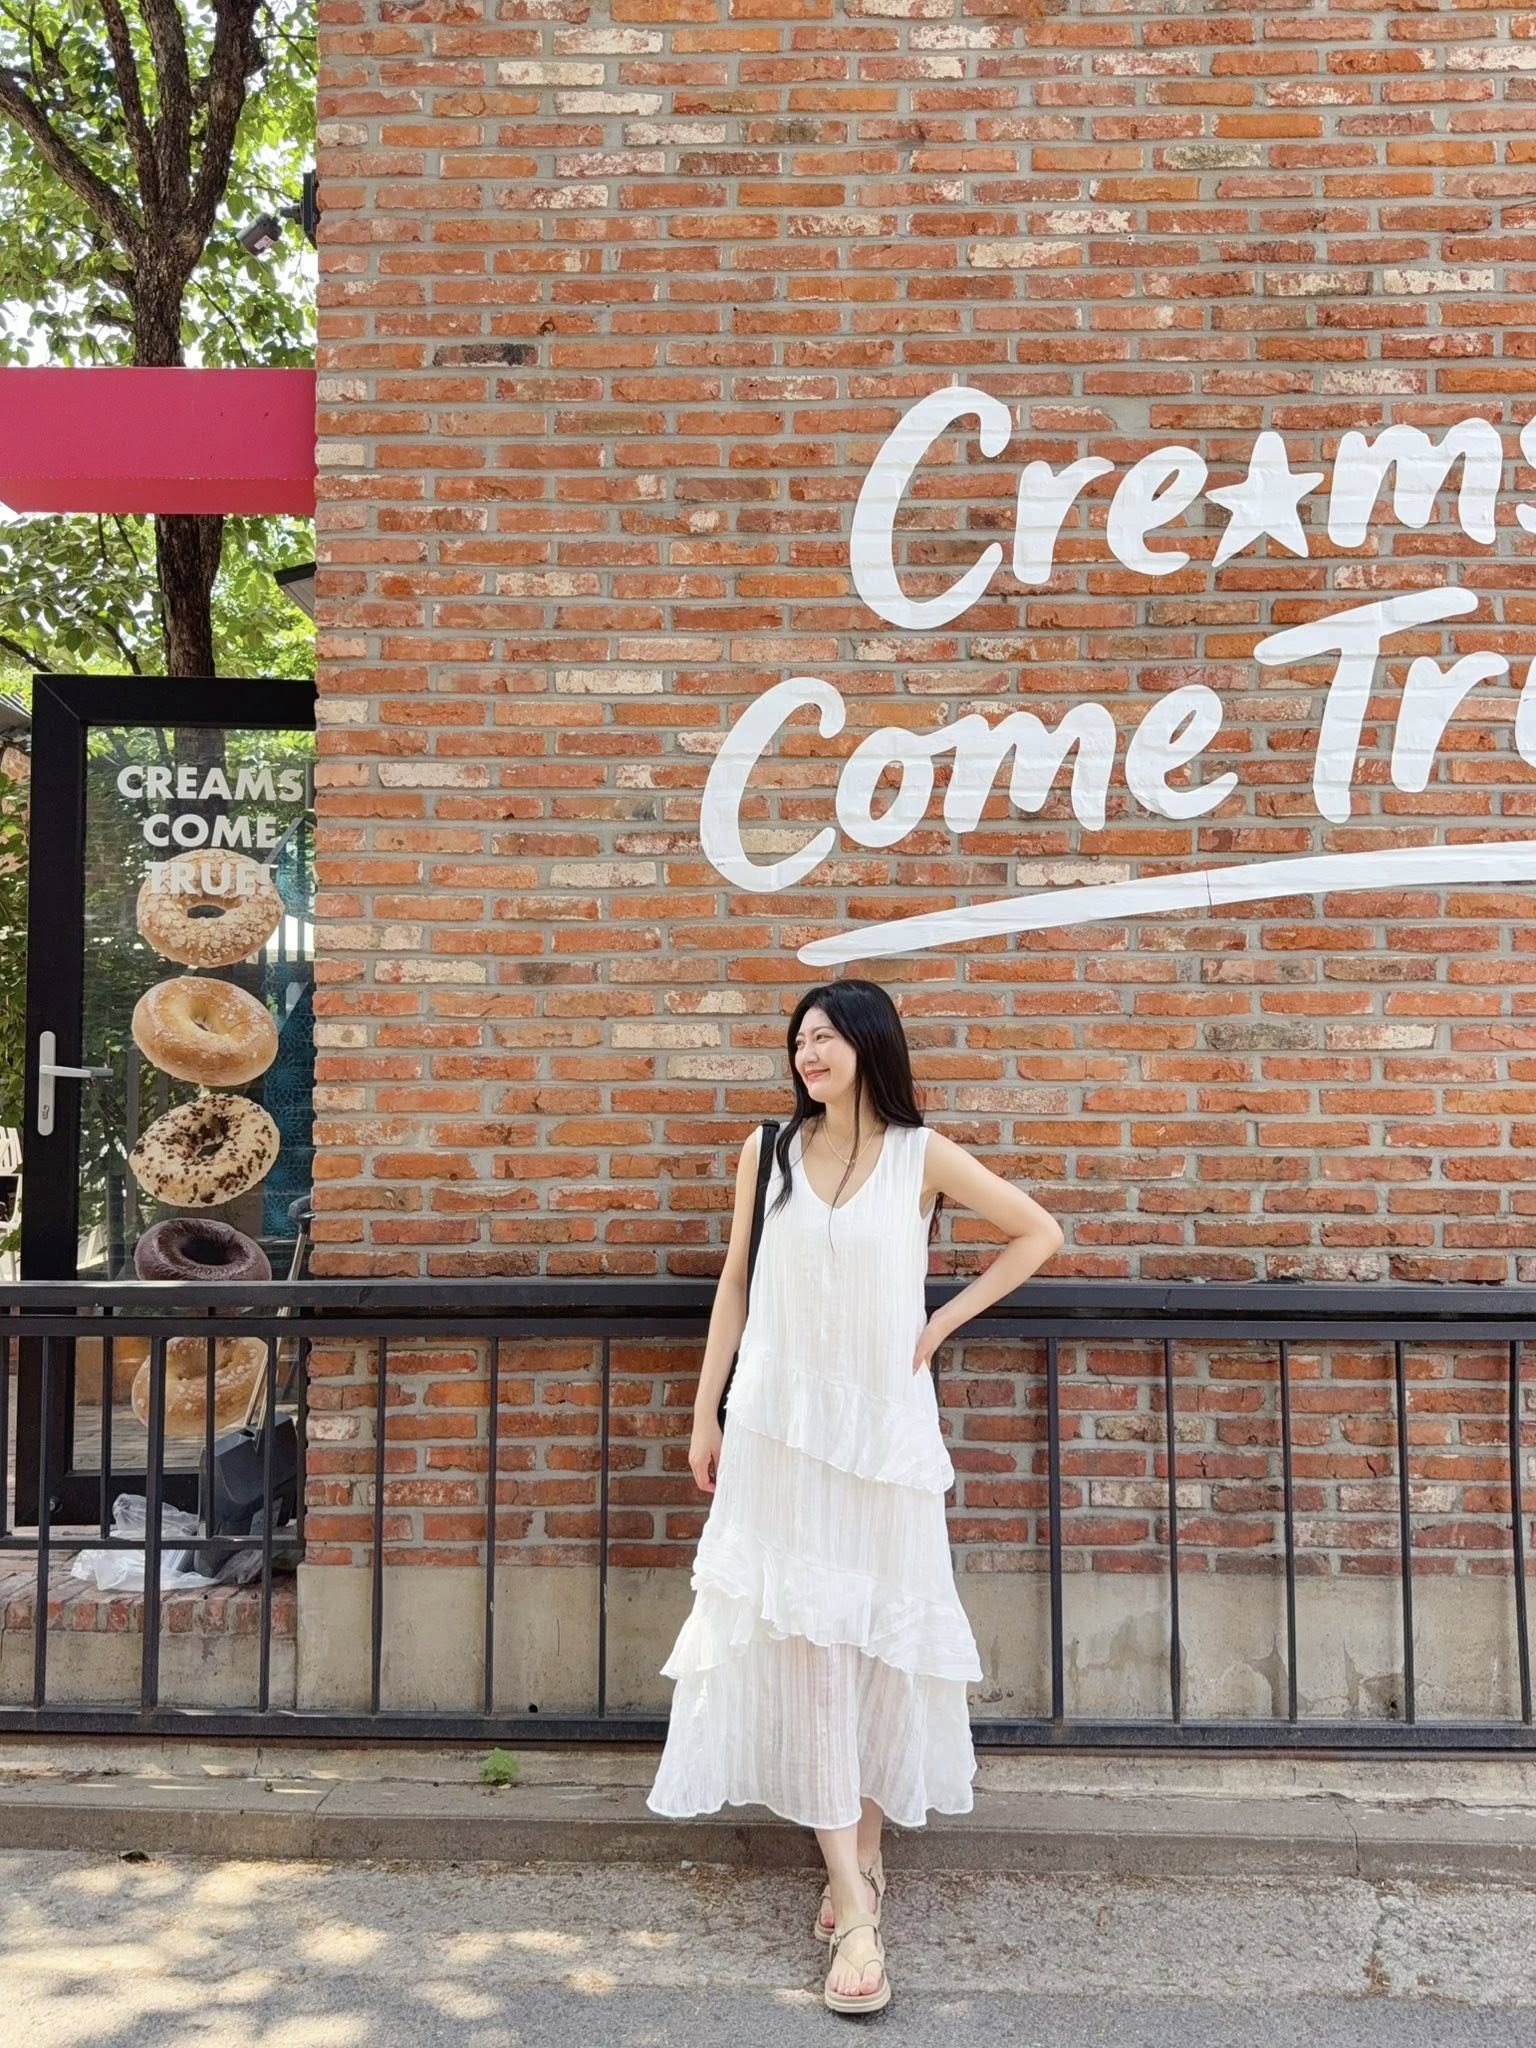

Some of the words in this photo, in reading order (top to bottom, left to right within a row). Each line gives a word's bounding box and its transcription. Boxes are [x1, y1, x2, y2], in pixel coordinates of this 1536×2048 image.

[700, 678, 1238, 892] Come
[1255, 587, 1536, 823] Tr
[116, 765, 304, 802] CREAMS
[143, 813, 277, 848] COME
[146, 861, 271, 895] TRUE!
